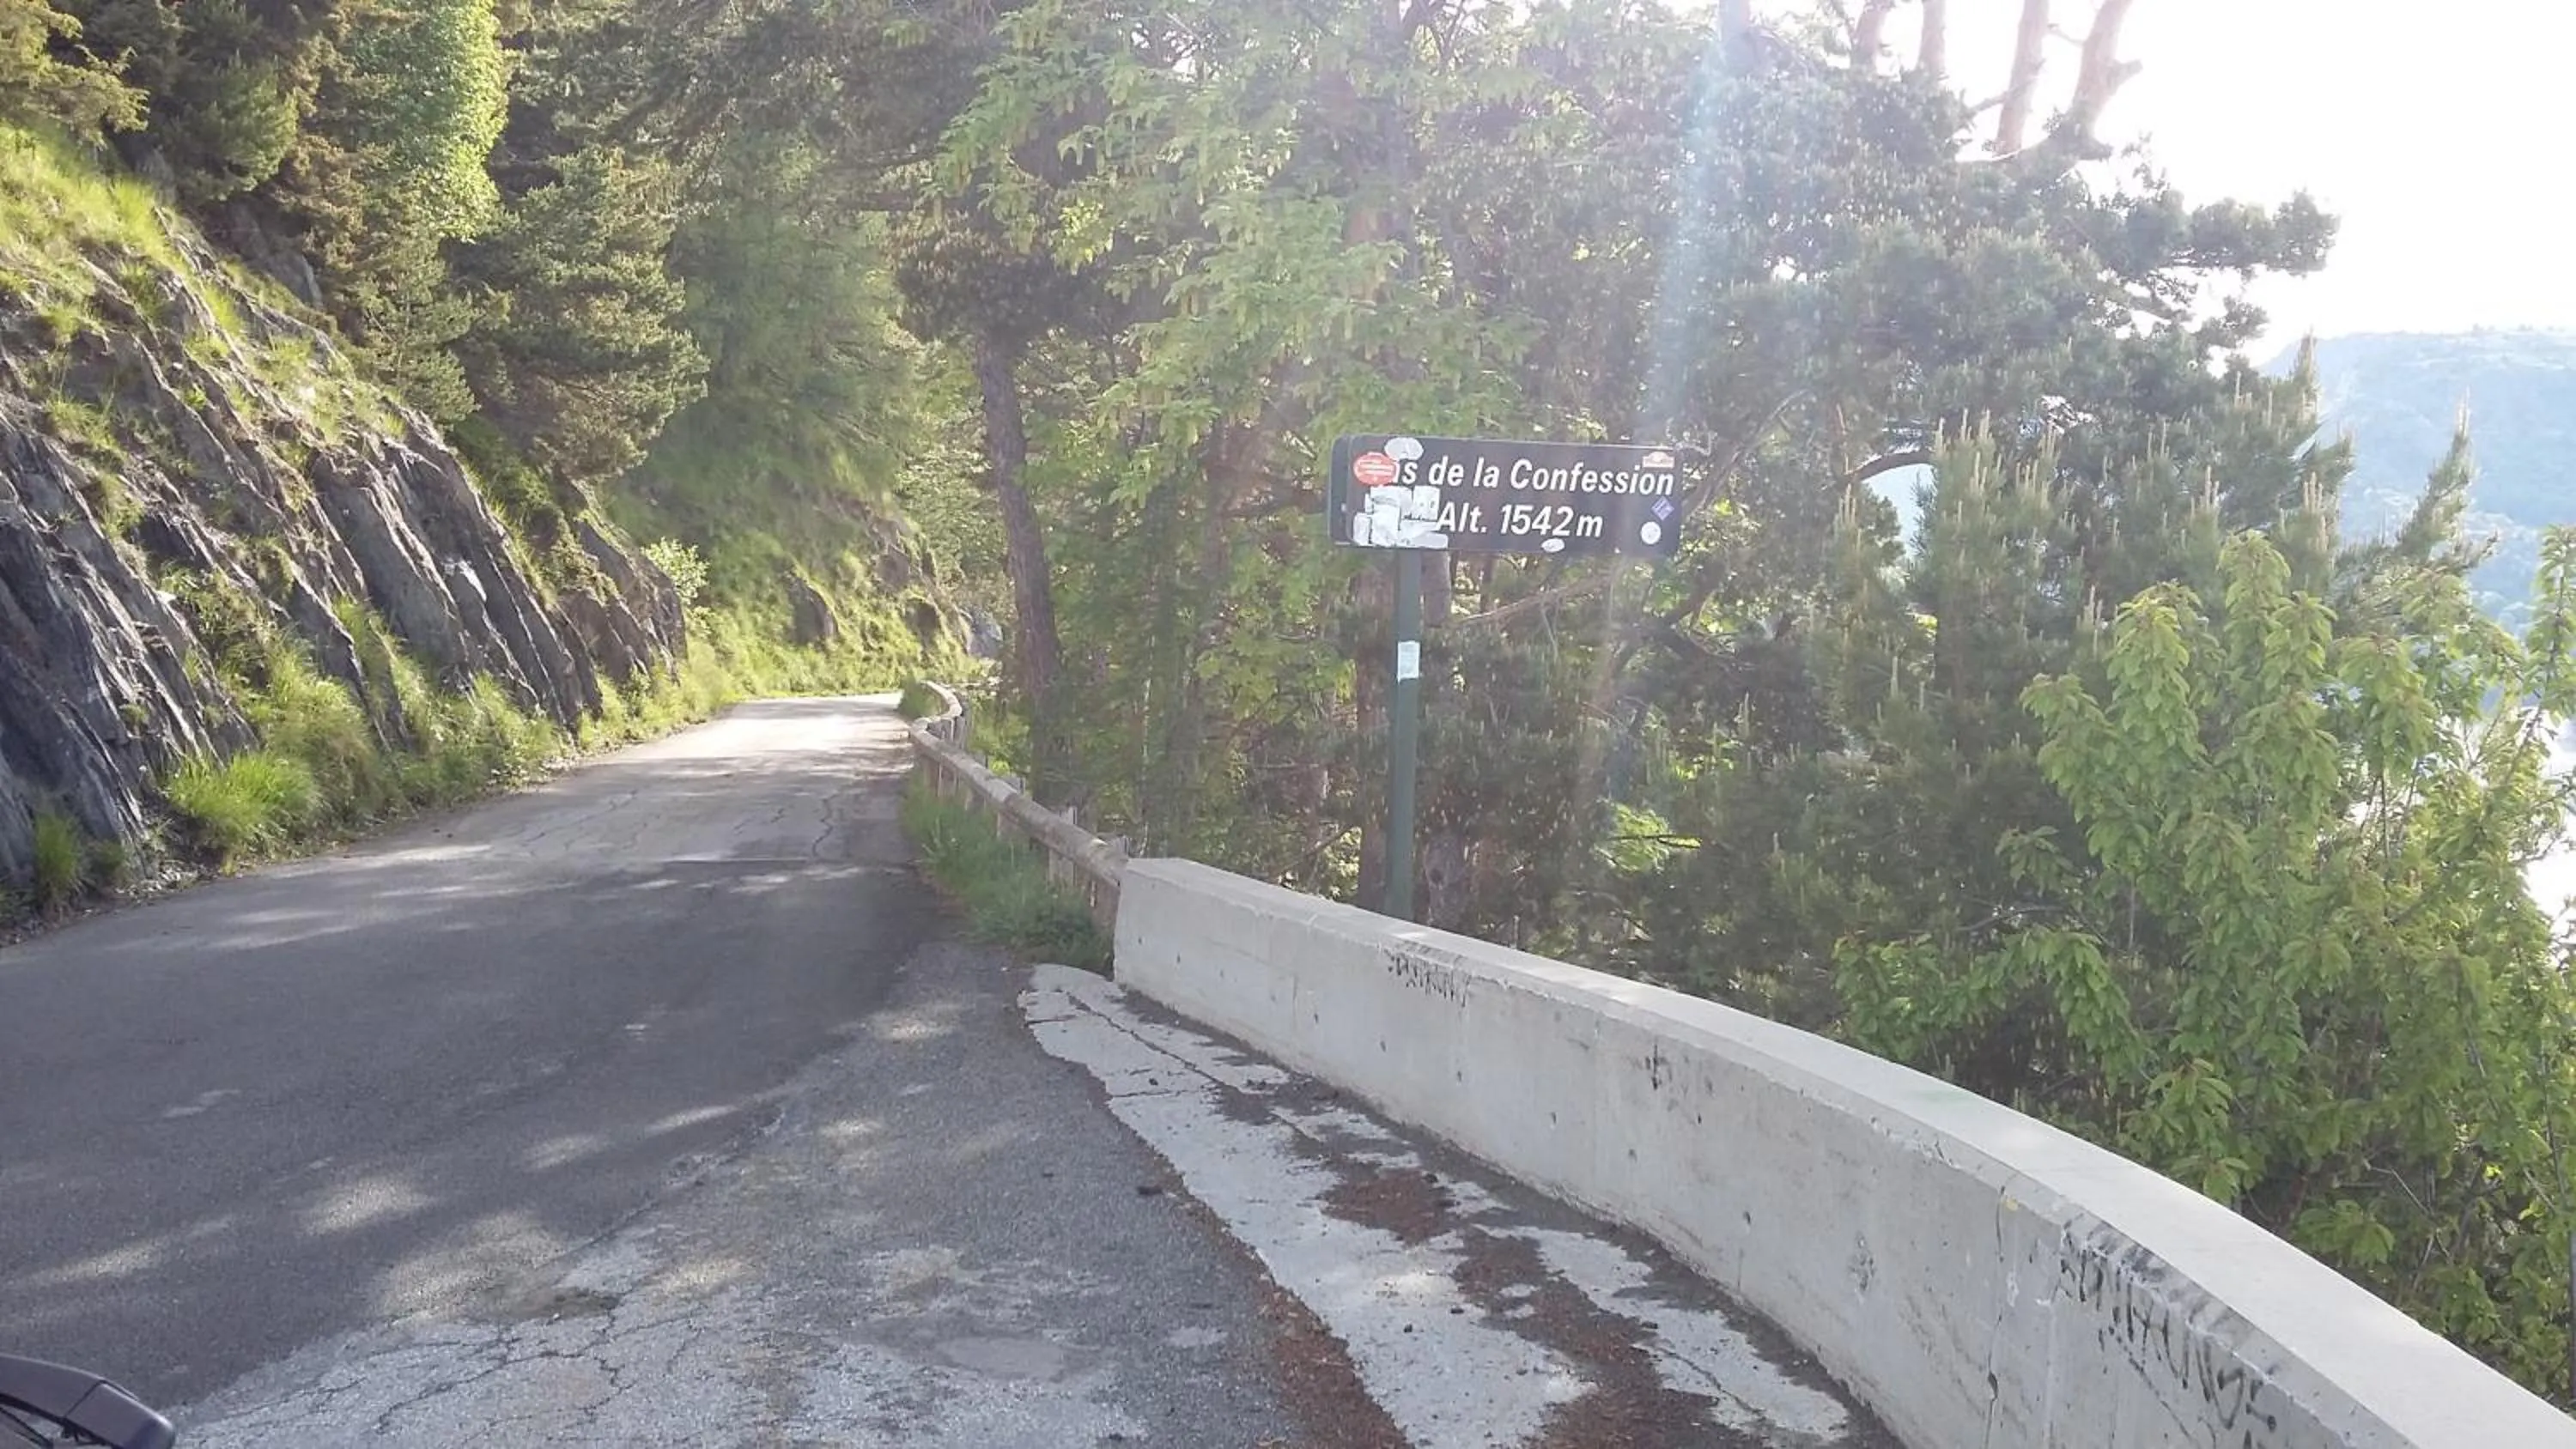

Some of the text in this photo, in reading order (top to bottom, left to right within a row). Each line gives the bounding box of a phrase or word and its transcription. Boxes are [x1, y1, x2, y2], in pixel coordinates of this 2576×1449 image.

[1428, 455, 1464, 487] de
[1473, 456, 1500, 488] la
[1510, 458, 1674, 496] Confession
[1436, 501, 1488, 534] Alt.
